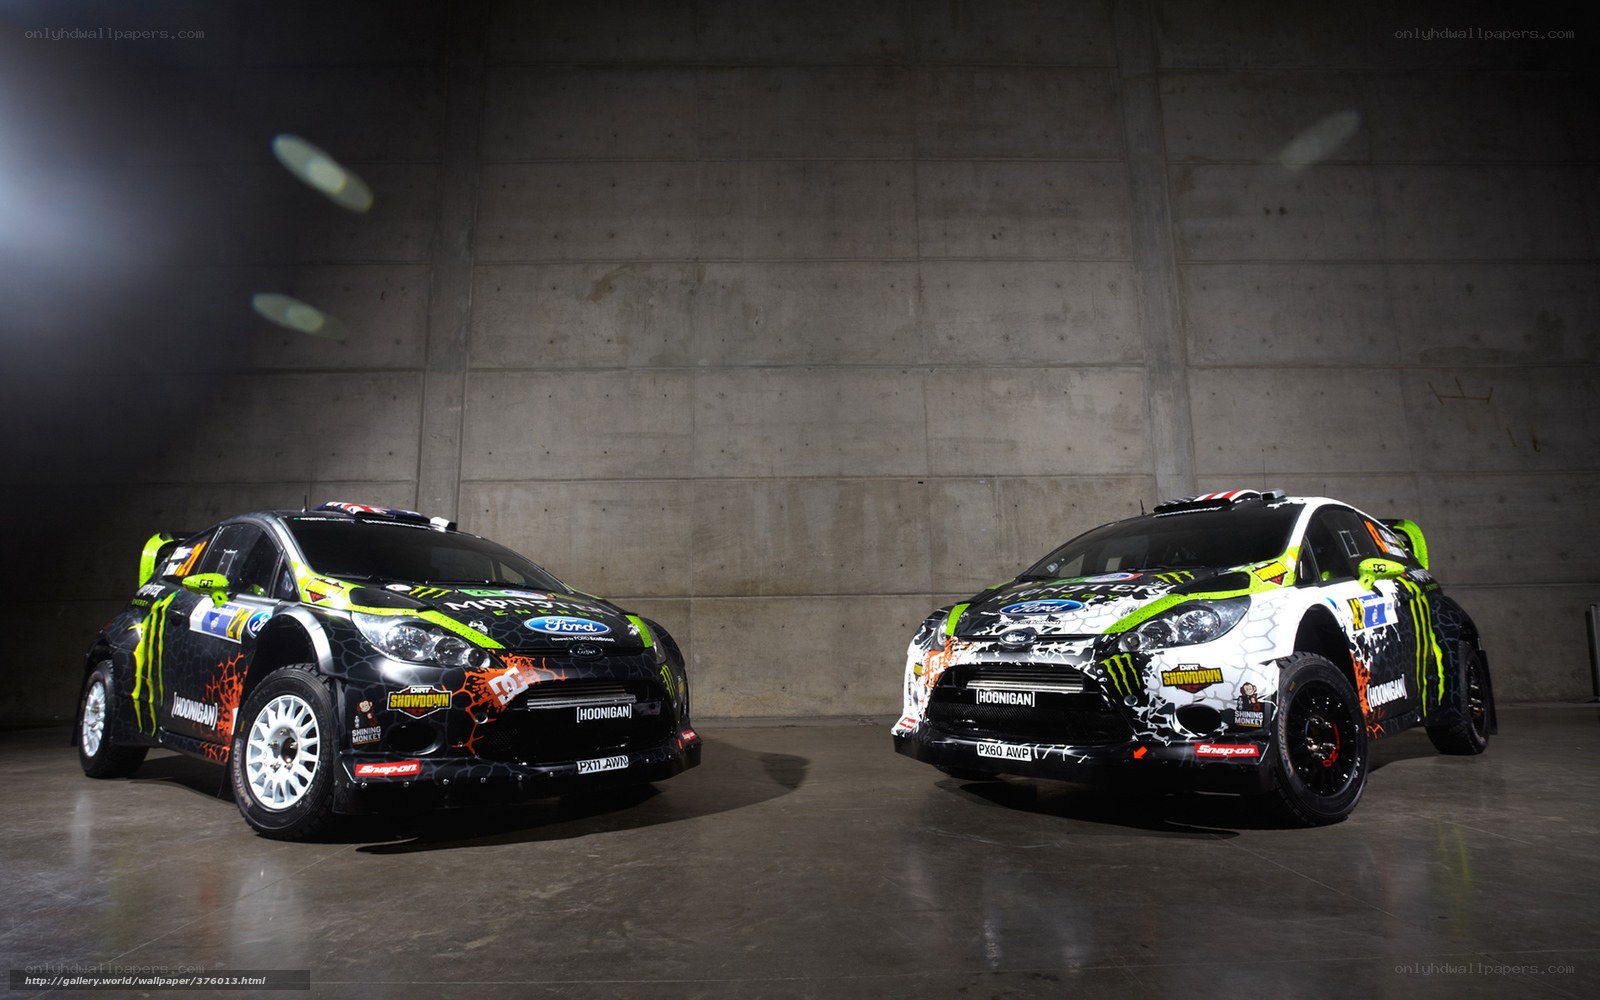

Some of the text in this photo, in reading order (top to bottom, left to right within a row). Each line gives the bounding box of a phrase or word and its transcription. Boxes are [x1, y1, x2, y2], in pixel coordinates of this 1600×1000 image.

[1009, 600, 1069, 614] Ford
[544, 617, 598, 633] Ford
[1162, 670, 1221, 685] SHOWDOWN
[390, 694, 449, 708] SHOWDOWN
[1235, 710, 1263, 719] SHINING
[1235, 717, 1263, 725] MONKEY
[352, 726, 381, 737] SHINING
[352, 732, 381, 743] MONKEY
[979, 743, 1029, 759] PX60 AWP
[1197, 744, 1255, 756] Snap-on
[358, 764, 417, 775] Snap-on
[580, 756, 628, 772] PX11 AWN
